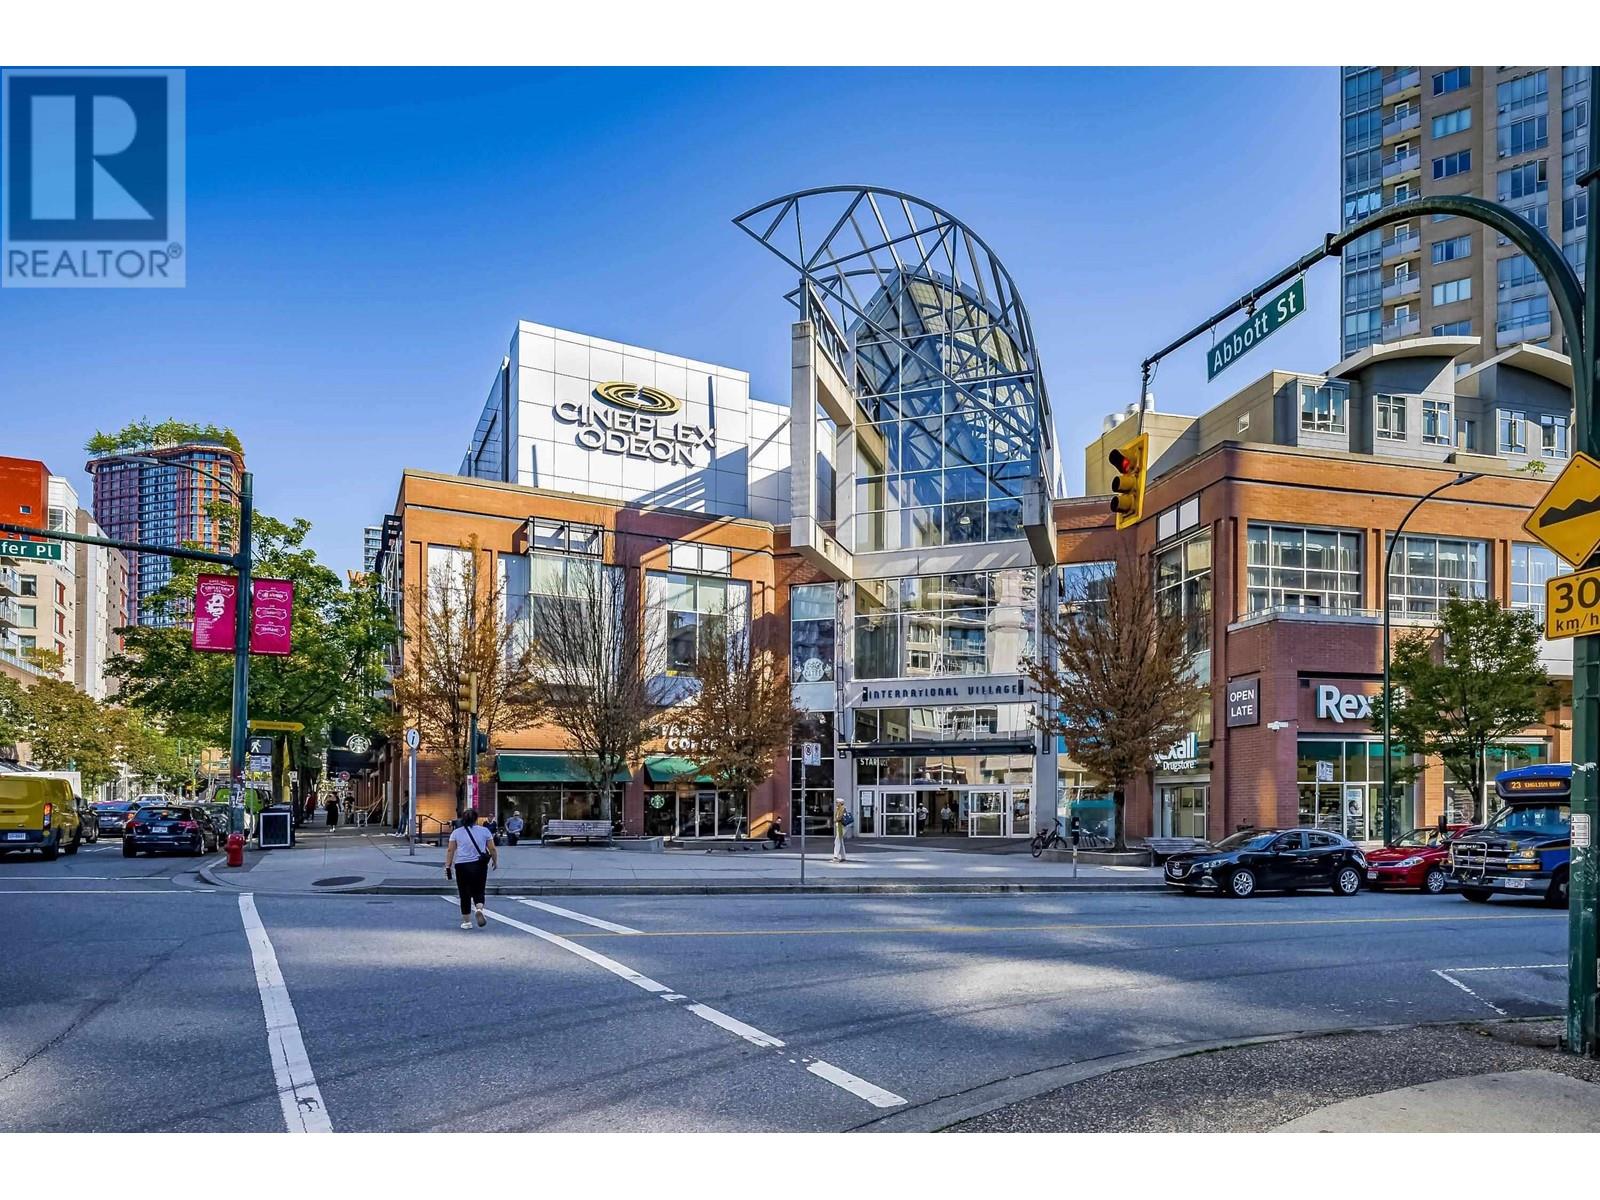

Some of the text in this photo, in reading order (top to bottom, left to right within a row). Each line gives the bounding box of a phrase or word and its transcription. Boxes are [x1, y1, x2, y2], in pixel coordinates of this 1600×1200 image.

[1213, 291, 1297, 372] Abbott St
[552, 400, 717, 449] CINEPLEX
[575, 426, 698, 468] ODEON
[36, 545, 53, 557] Pl
[1555, 576, 1600, 614] 30
[1556, 612, 1599, 633] km/h
[868, 683, 1017, 700] INTERNATIONAL VILLAGE
[1230, 689, 1255, 702] OPEN
[1231, 704, 1253, 717] LATE
[1317, 685, 1406, 723] Rex
[1163, 760, 1197, 772] Drugstore
[1511, 781, 1522, 789] 23
